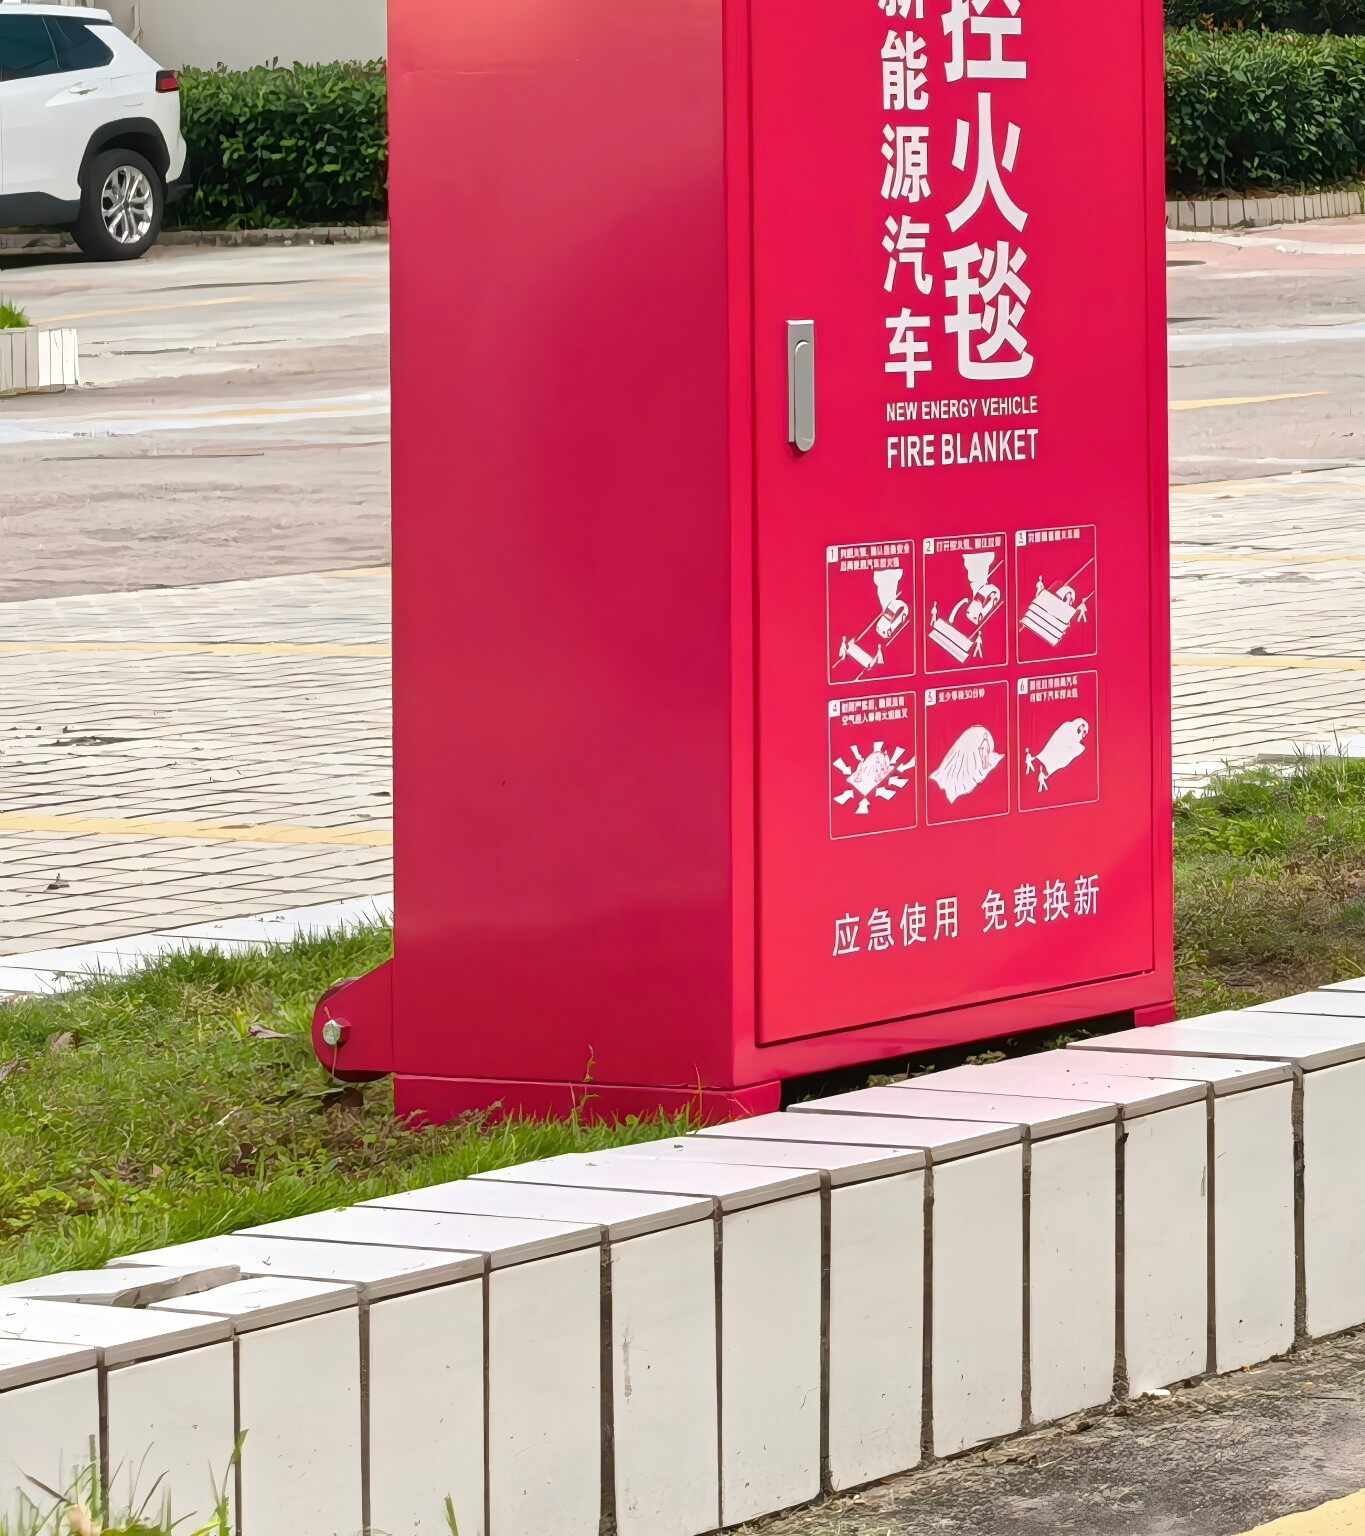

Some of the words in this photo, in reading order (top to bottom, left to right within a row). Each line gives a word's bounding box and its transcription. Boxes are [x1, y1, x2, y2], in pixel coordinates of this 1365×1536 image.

[886, 401, 918, 423] NEW
[922, 397, 978, 420] ENERGY
[981, 395, 1039, 417] VEHICLE
[887, 433, 936, 470] FIRE
[940, 428, 1039, 466] BLANKET
[832, 896, 959, 957] 应急使用
[981, 873, 1100, 933] 免费换新
